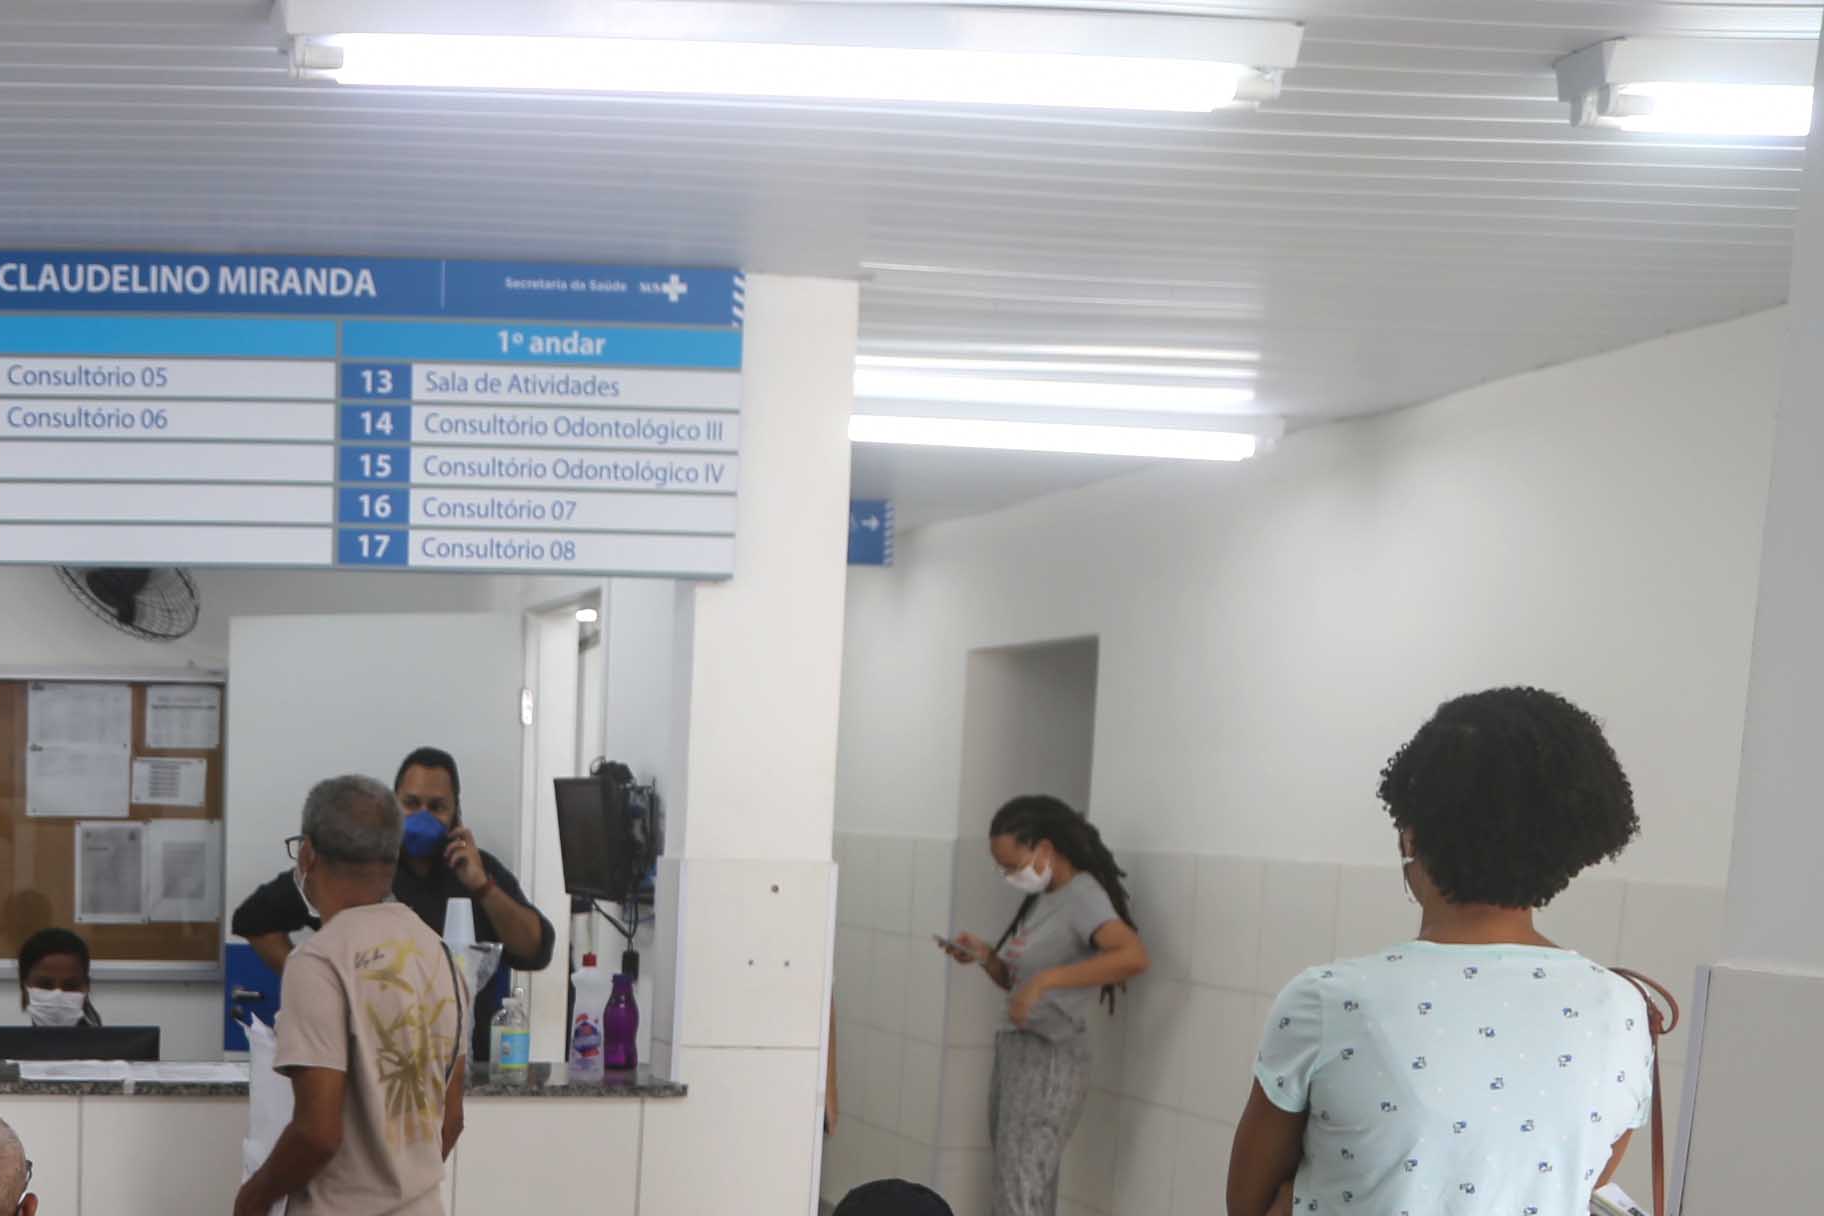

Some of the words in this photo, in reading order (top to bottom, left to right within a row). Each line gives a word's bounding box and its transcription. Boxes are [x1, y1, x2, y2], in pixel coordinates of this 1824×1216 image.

[218, 265, 378, 298] MIRANDA
[505, 276, 567, 290] Secretaria
[590, 279, 628, 292] Saúde
[529, 331, 607, 356] andar
[7, 364, 135, 388] Consultório
[141, 367, 168, 388] 05
[361, 369, 393, 394] 13
[426, 371, 468, 393] Sala
[474, 373, 501, 394] de
[507, 373, 620, 397] Atividades
[6, 406, 135, 429] Consultório
[141, 409, 168, 429] 06
[360, 411, 394, 436] 14
[425, 413, 548, 437] Consultório
[554, 416, 701, 444] Odontológico
[706, 420, 723, 441] III
[360, 454, 392, 478] 15
[424, 455, 547, 479] Consultório
[552, 458, 699, 486] Odontológico
[704, 463, 725, 484] IV
[359, 494, 392, 518] 16
[423, 497, 545, 520] Consultório
[551, 500, 577, 521] 07
[358, 535, 391, 558] 17
[422, 537, 544, 560] Consultório
[550, 540, 576, 561] 08
